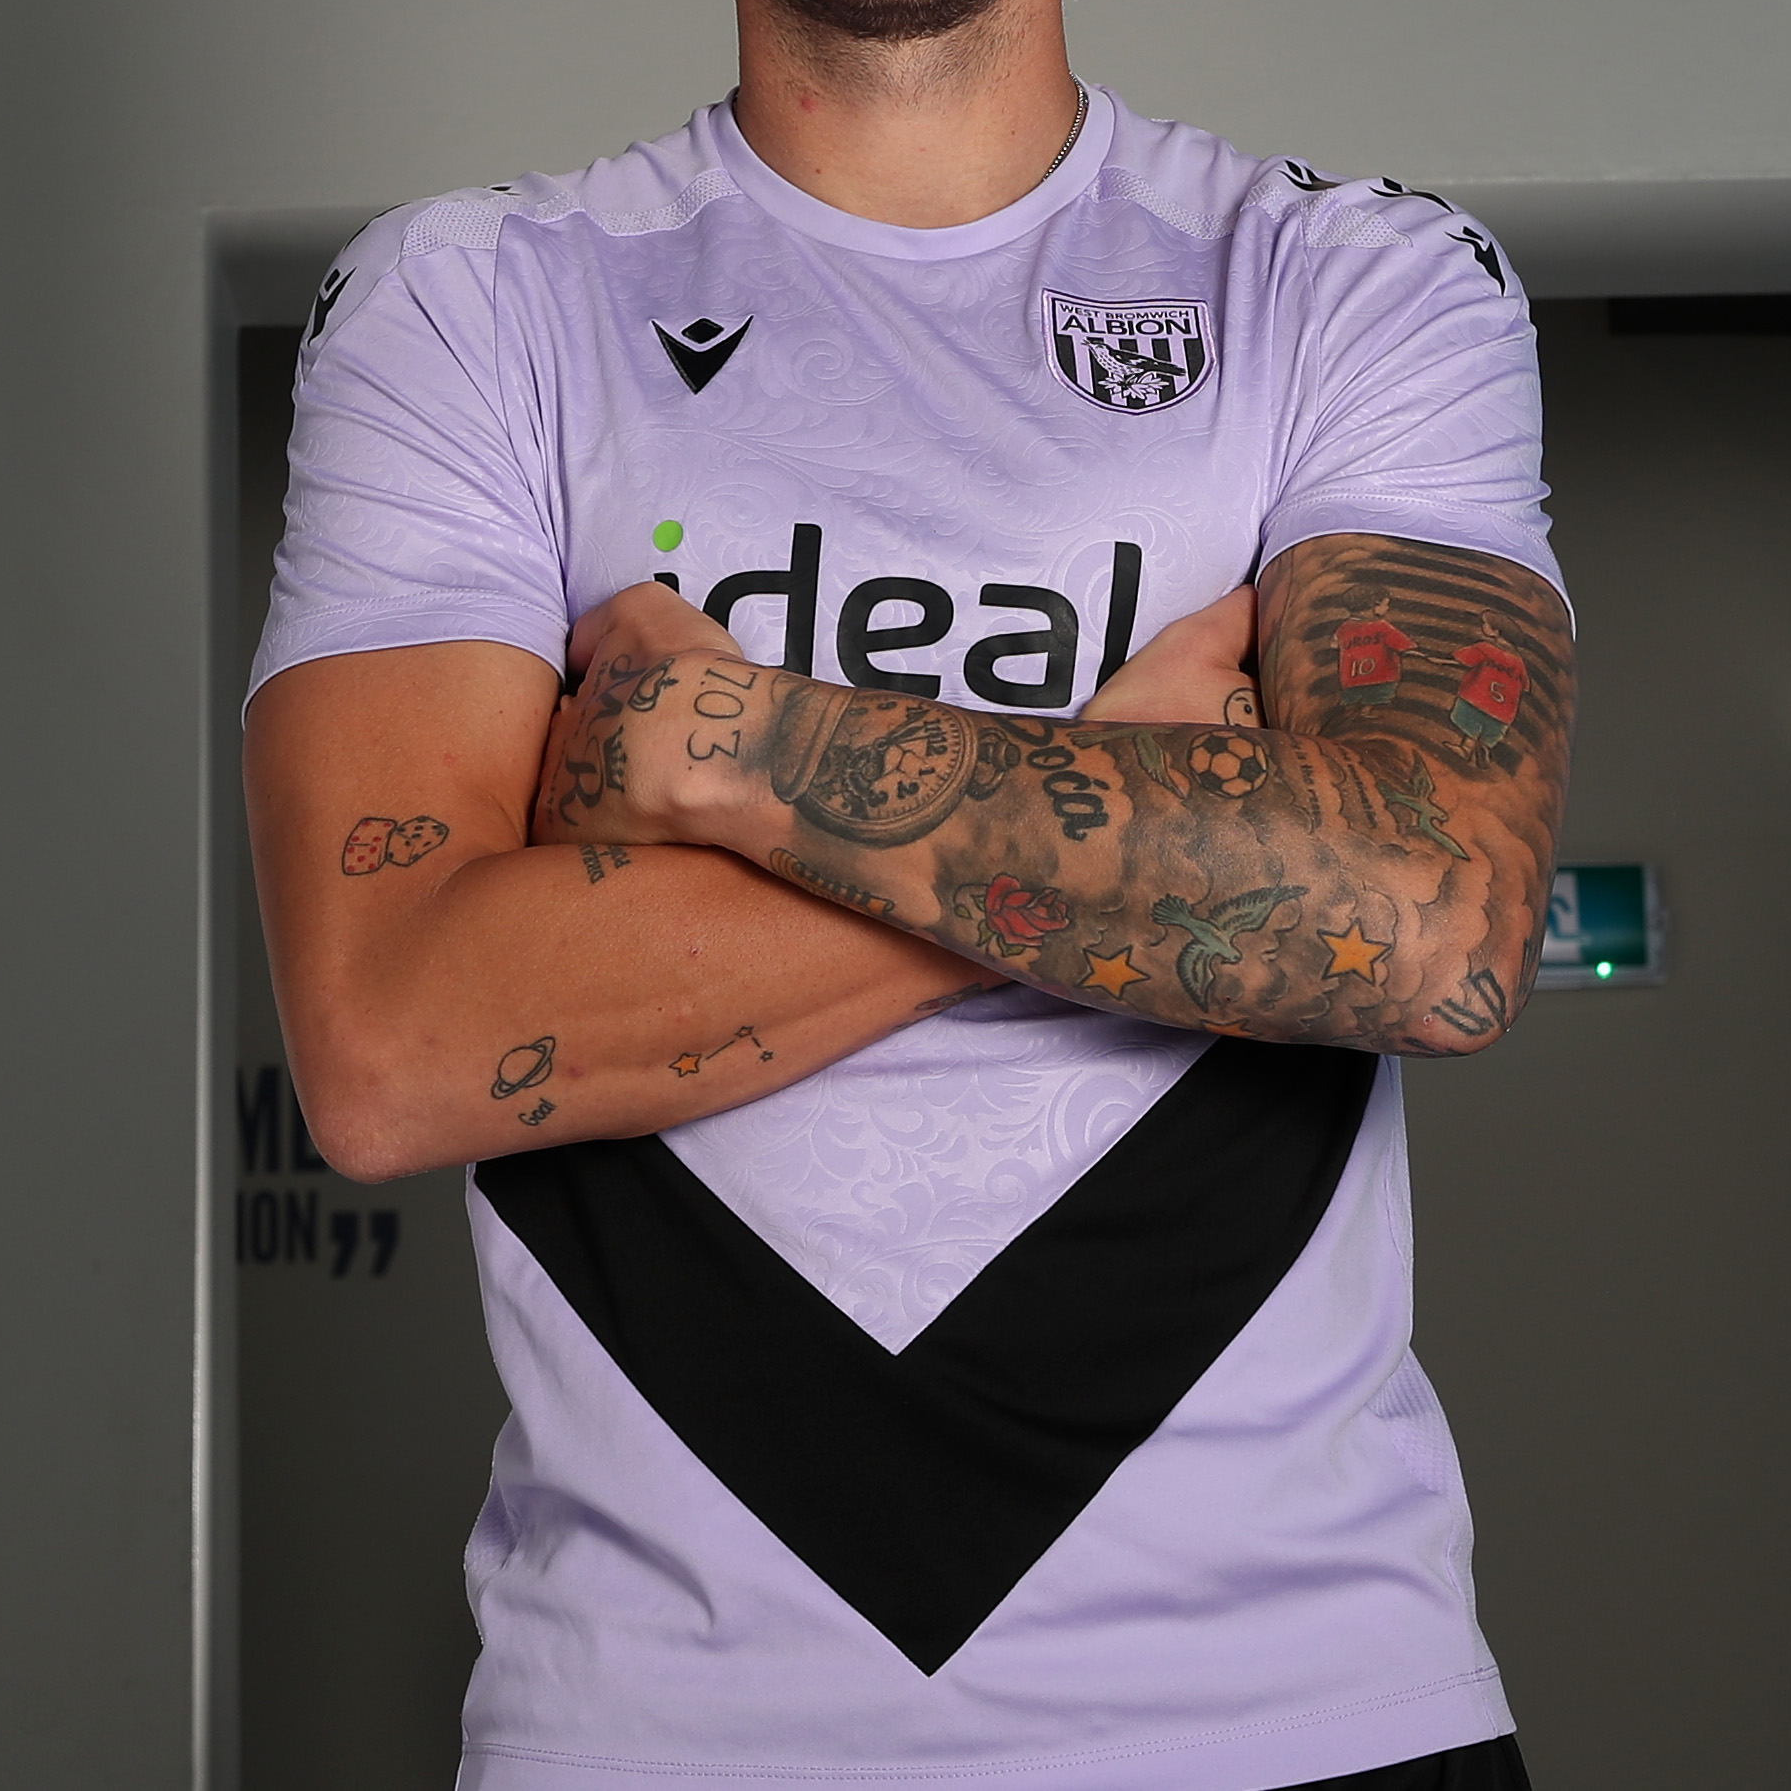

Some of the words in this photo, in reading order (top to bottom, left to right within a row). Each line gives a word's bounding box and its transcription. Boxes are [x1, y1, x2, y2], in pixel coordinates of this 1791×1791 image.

[1061, 303, 1100, 318] WEST
[1105, 310, 1189, 320] BROMWICH
[1061, 314, 1192, 335] ALBION
[1488, 681, 1507, 704] 5
[517, 1097, 558, 1126] Goal
